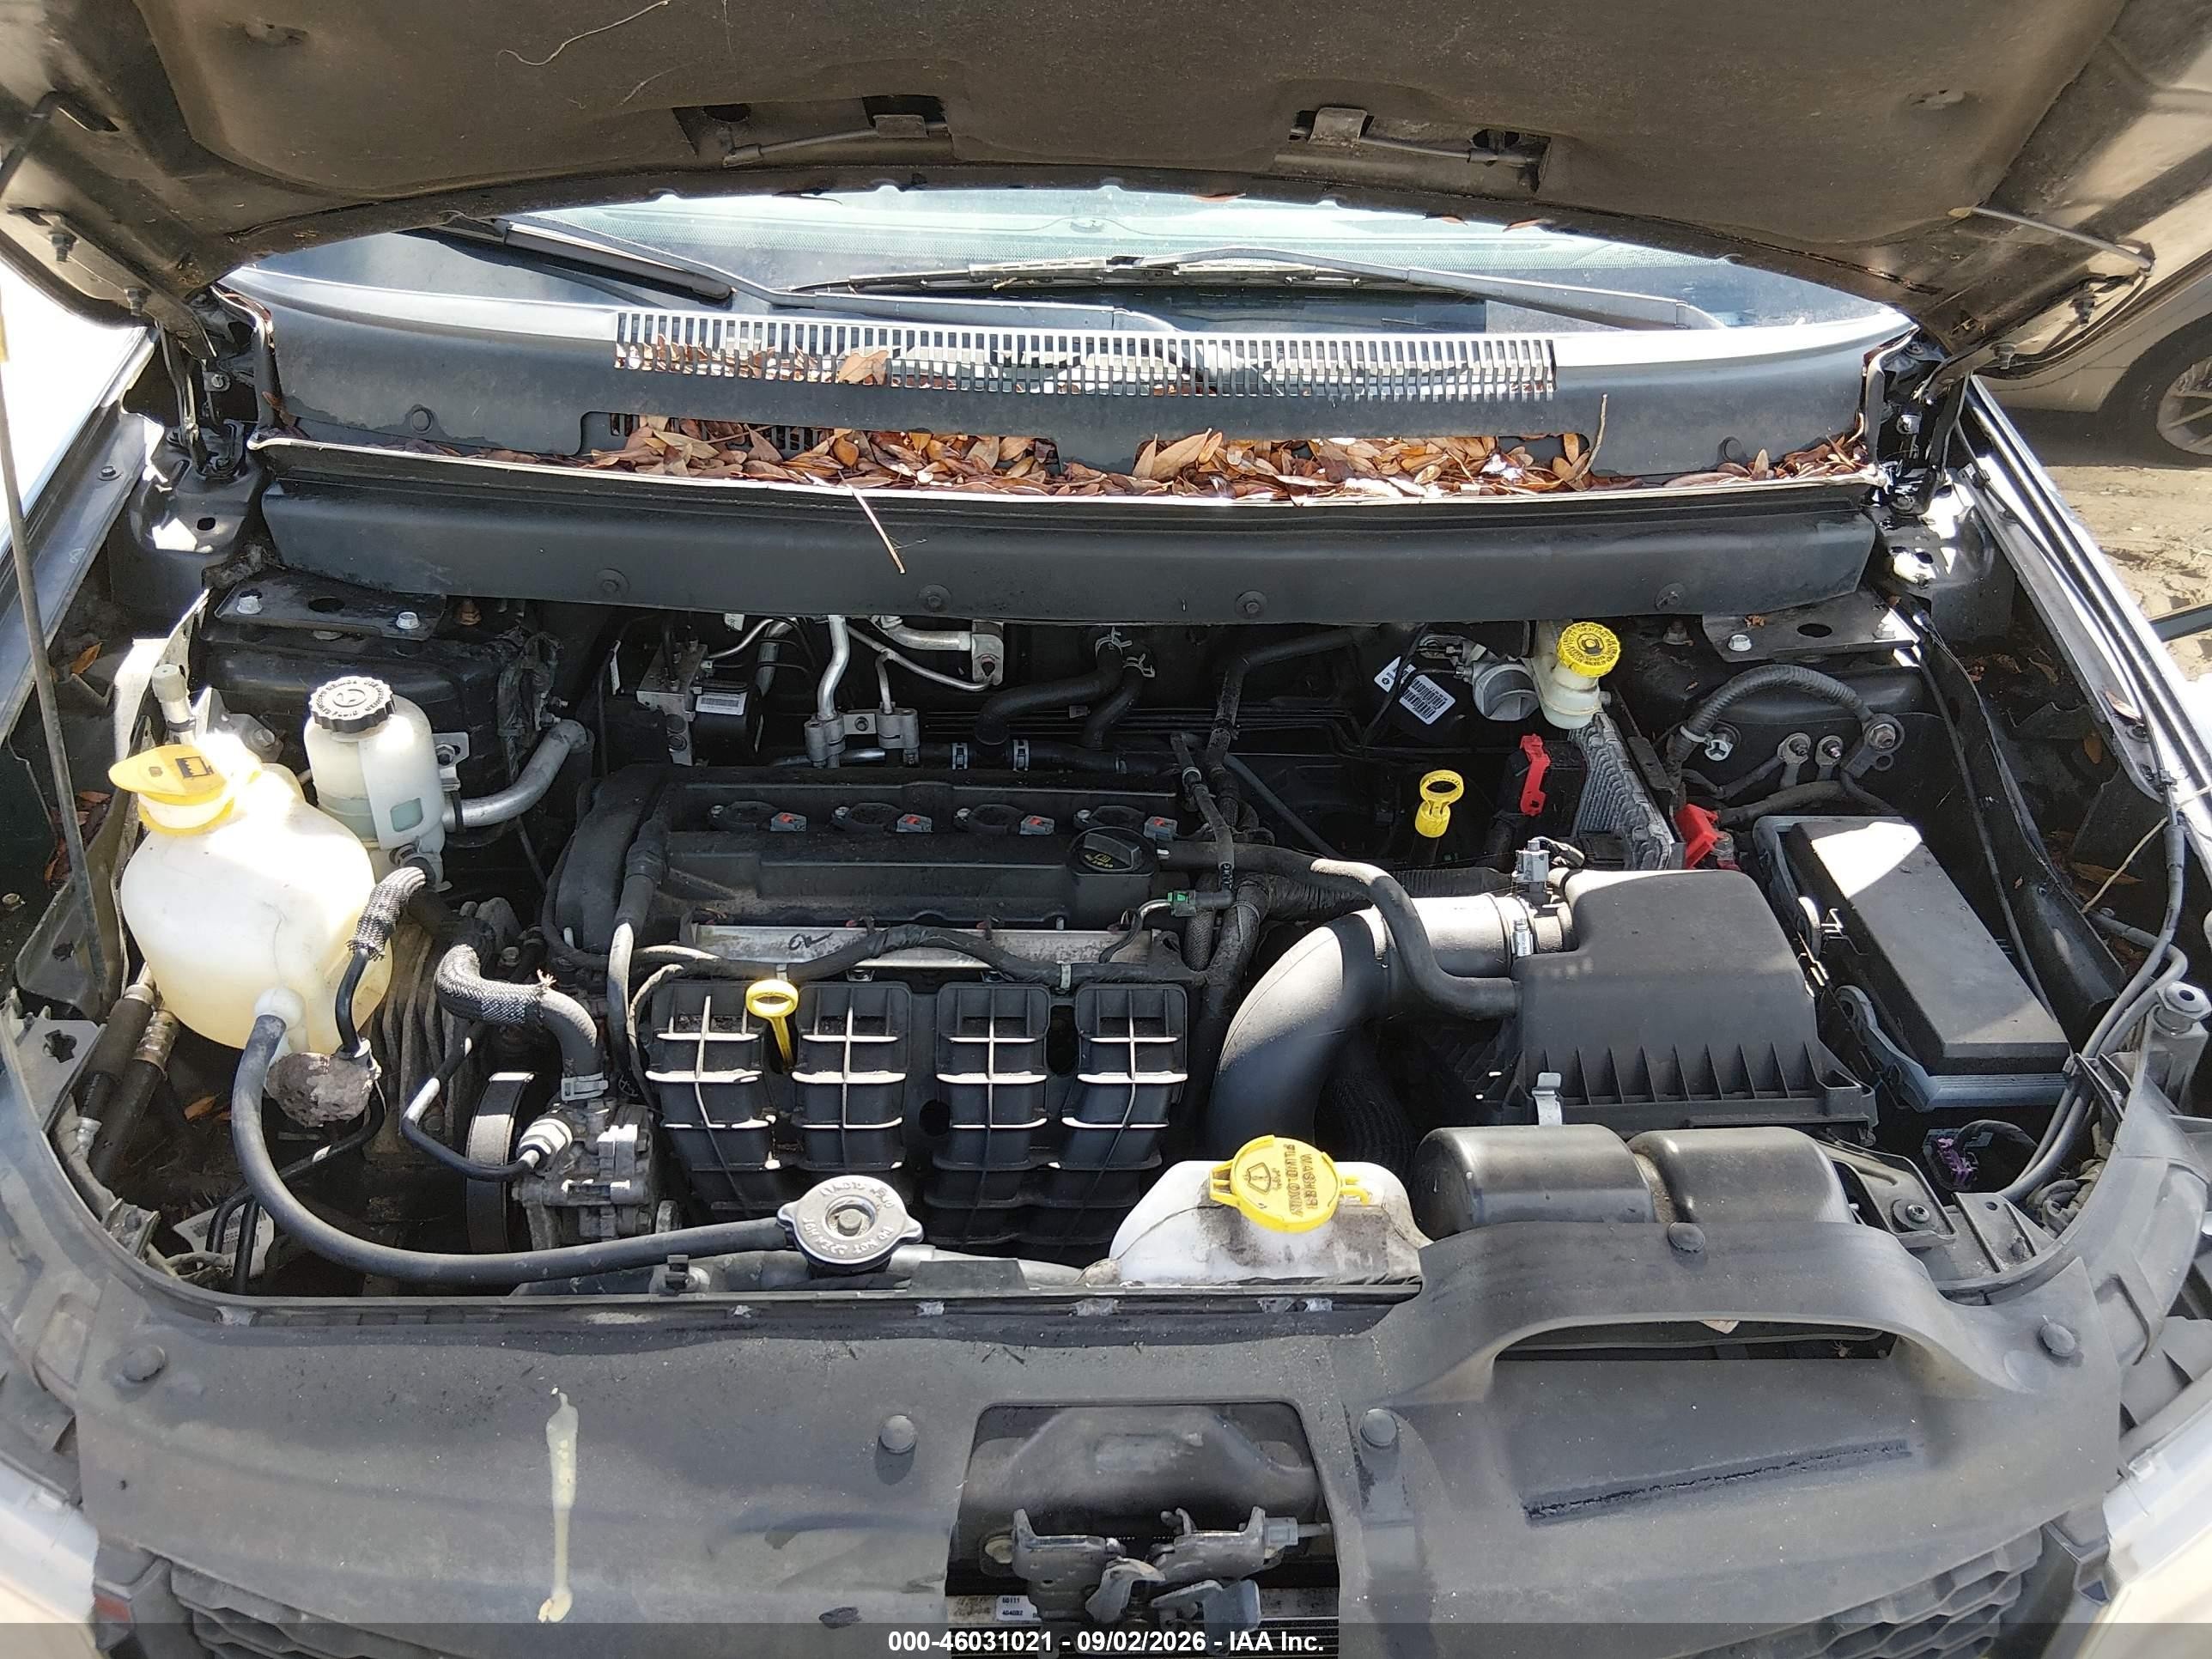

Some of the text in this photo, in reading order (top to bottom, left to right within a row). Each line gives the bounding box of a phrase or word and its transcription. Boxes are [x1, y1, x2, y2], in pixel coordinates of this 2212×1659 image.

[1300, 1153, 1318, 1209] WASHER
[802, 1217, 817, 1235] HOT
[853, 1238, 879, 1254] NOT
